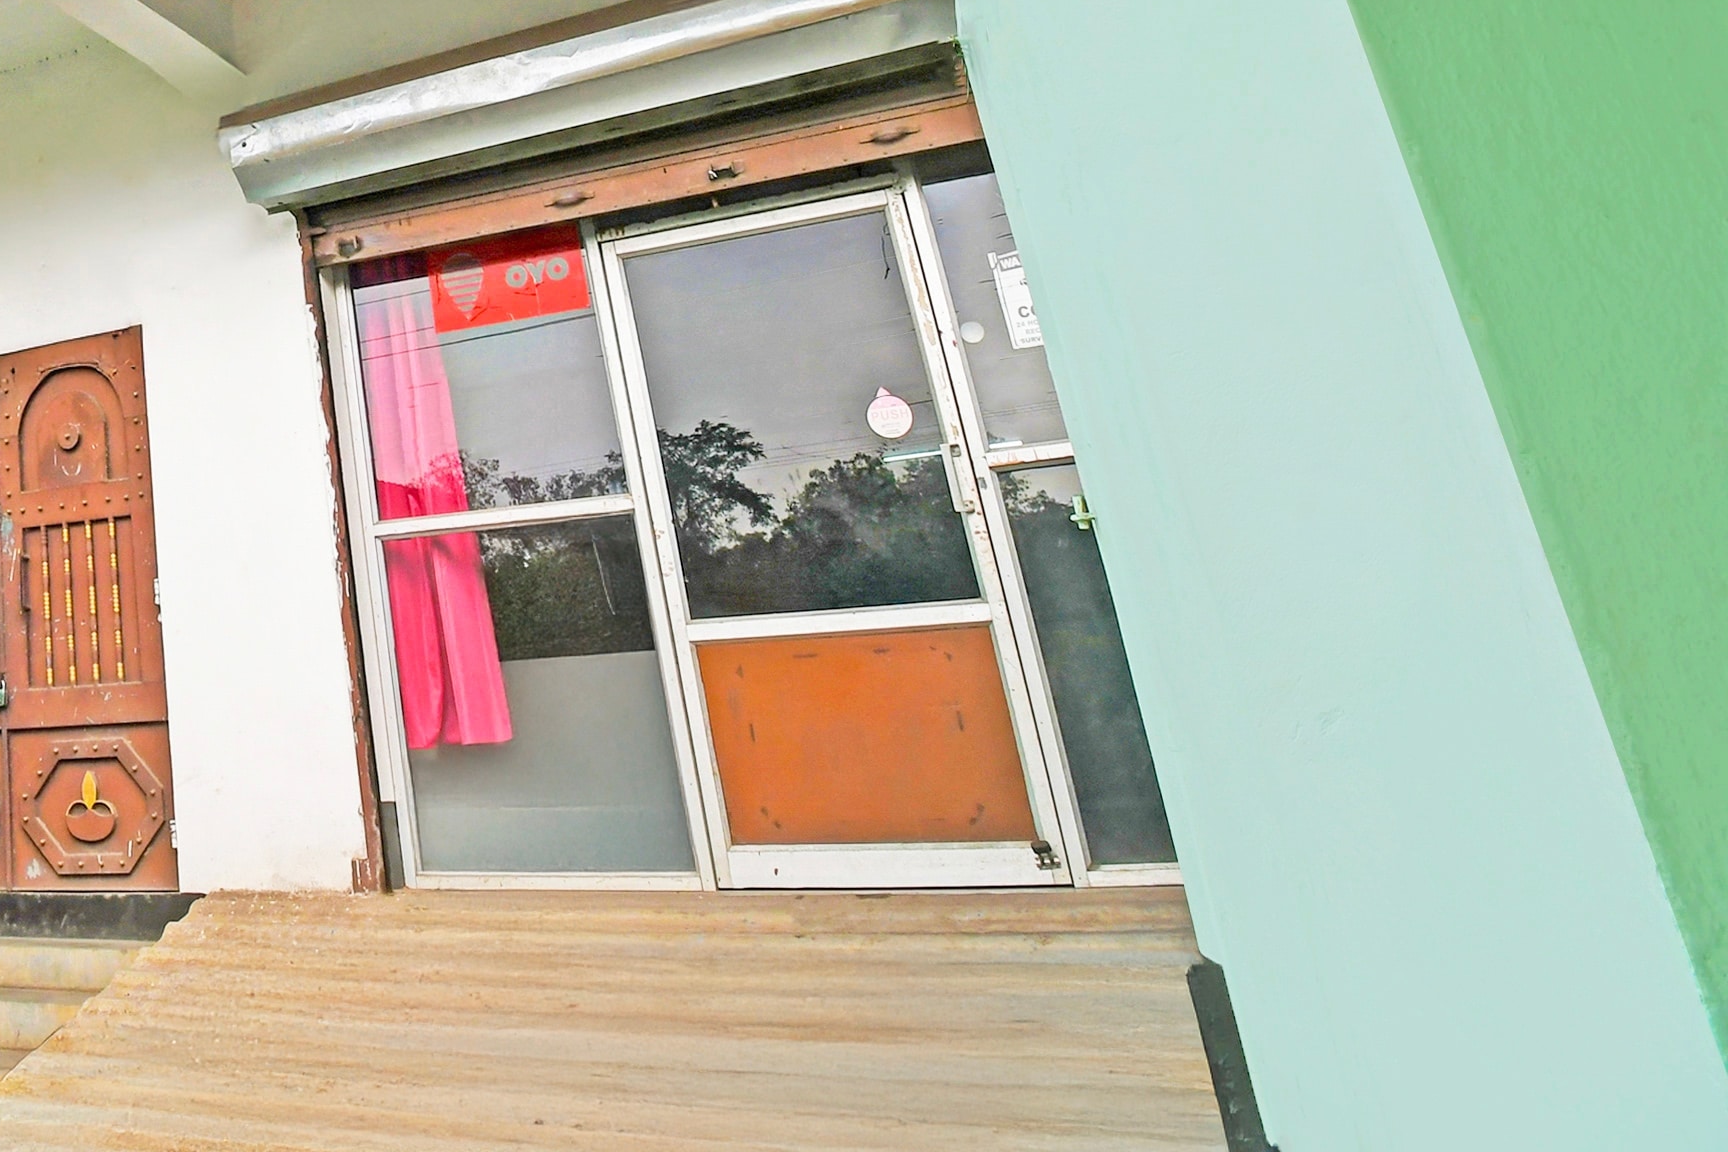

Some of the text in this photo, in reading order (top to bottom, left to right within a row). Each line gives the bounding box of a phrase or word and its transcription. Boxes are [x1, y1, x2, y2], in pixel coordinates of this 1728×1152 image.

[999, 256, 1020, 269] WA
[505, 257, 569, 288] OYO
[871, 408, 909, 422] PUSH
